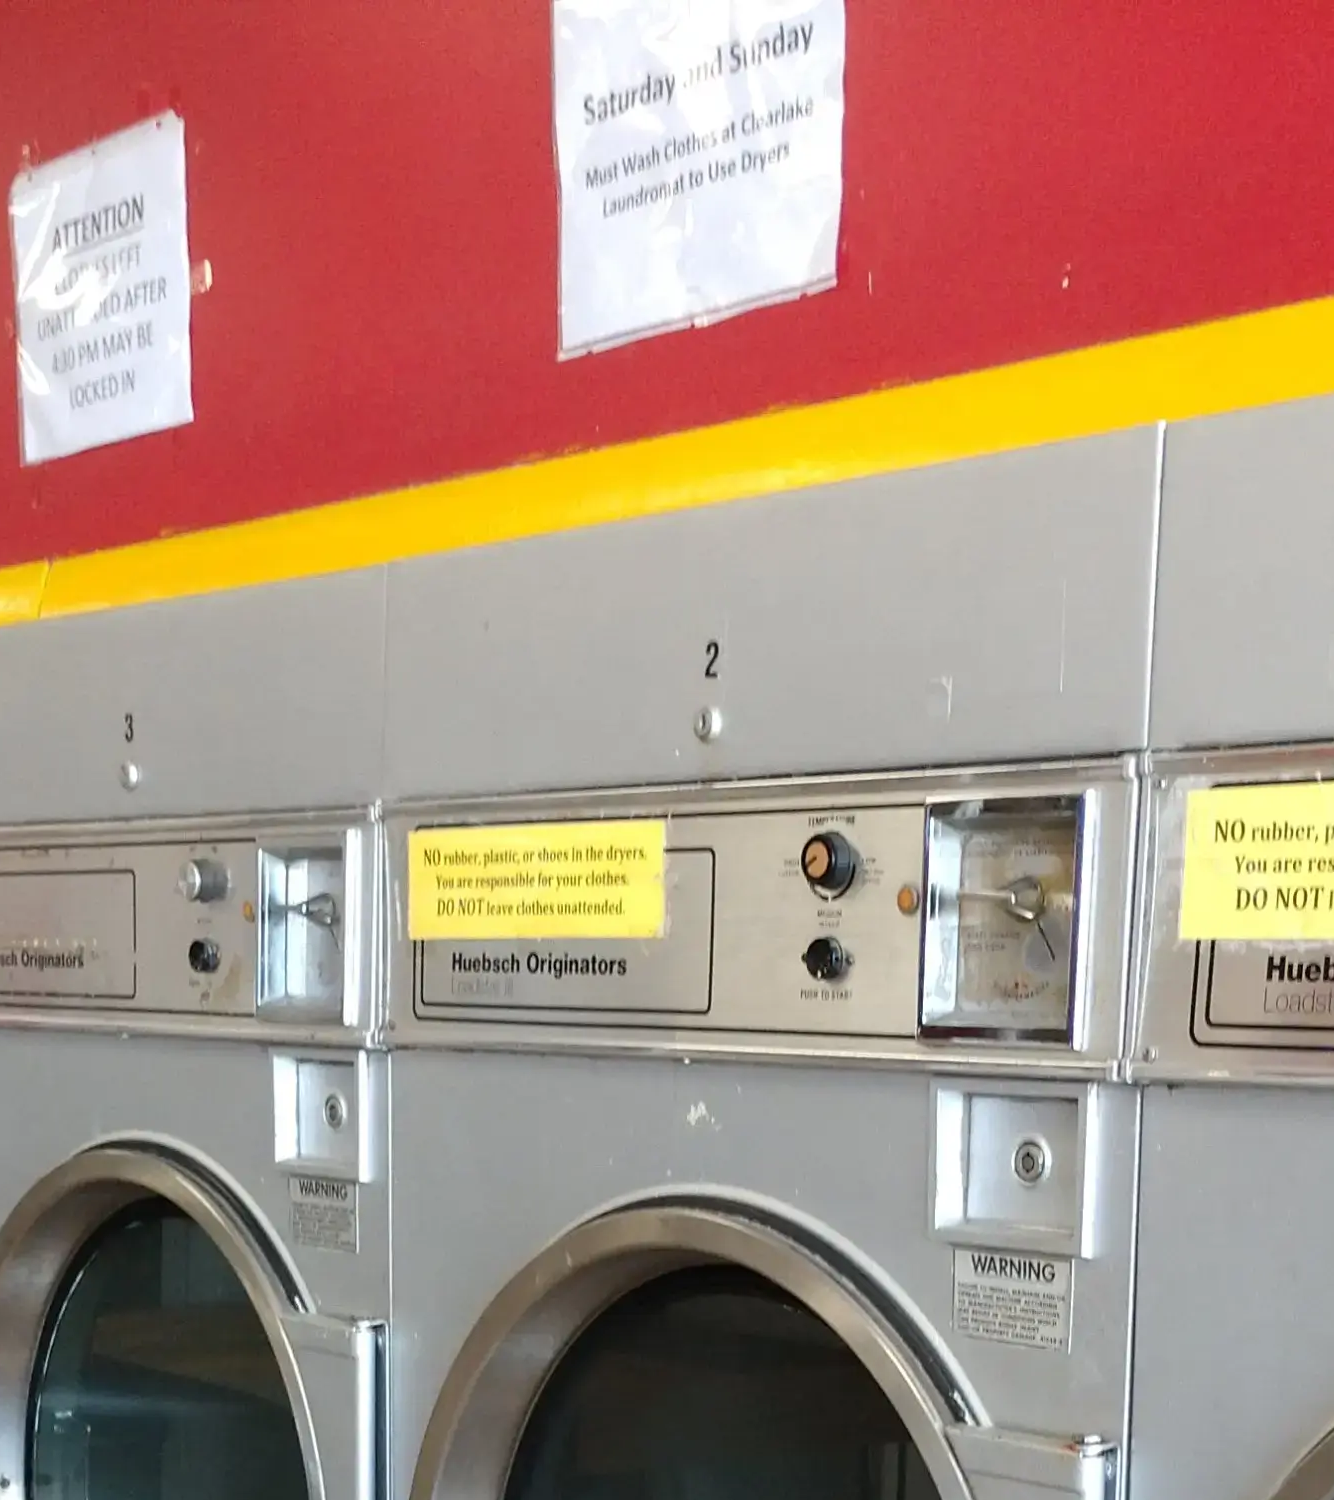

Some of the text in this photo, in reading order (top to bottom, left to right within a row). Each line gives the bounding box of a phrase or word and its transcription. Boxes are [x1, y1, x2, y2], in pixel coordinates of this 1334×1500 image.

[583, 72, 676, 126] Saturday
[729, 20, 814, 75] Sunday
[585, 97, 814, 190] Must Wash Clothes at Clearlake
[602, 140, 790, 218] Laundromat to Use Dryers
[51, 194, 144, 251] ATTENTION
[121, 277, 167, 312] AFTER
[77, 339, 100, 368] PM
[101, 329, 133, 362] MAY
[135, 322, 154, 350] BE
[69, 369, 136, 410] LOCKED IN
[704, 640, 720, 679] 2
[124, 711, 135, 743] 3
[1214, 817, 1246, 843] NO
[423, 847, 441, 867] NO
[523, 850, 535, 863] or
[537, 846, 569, 863] shoes
[571, 846, 583, 863] in
[586, 845, 604, 862] the
[1234, 854, 1268, 875] You
[1272, 856, 1303, 874] are
[436, 873, 455, 890] You
[457, 876, 473, 889] are
[475, 870, 535, 893] responsible
[538, 869, 554, 888] for
[556, 873, 583, 892] your
[436, 897, 455, 917] DO
[458, 897, 486, 917] NOT
[486, 900, 514, 916] leave
[516, 898, 554, 916] clothes
[1235, 886, 1268, 911] DO
[1275, 885, 1325, 911] NOT
[451, 951, 628, 980] Huebsch Originators
[298, 1179, 348, 1202] WARNING
[971, 1253, 1056, 1283] WARNING
